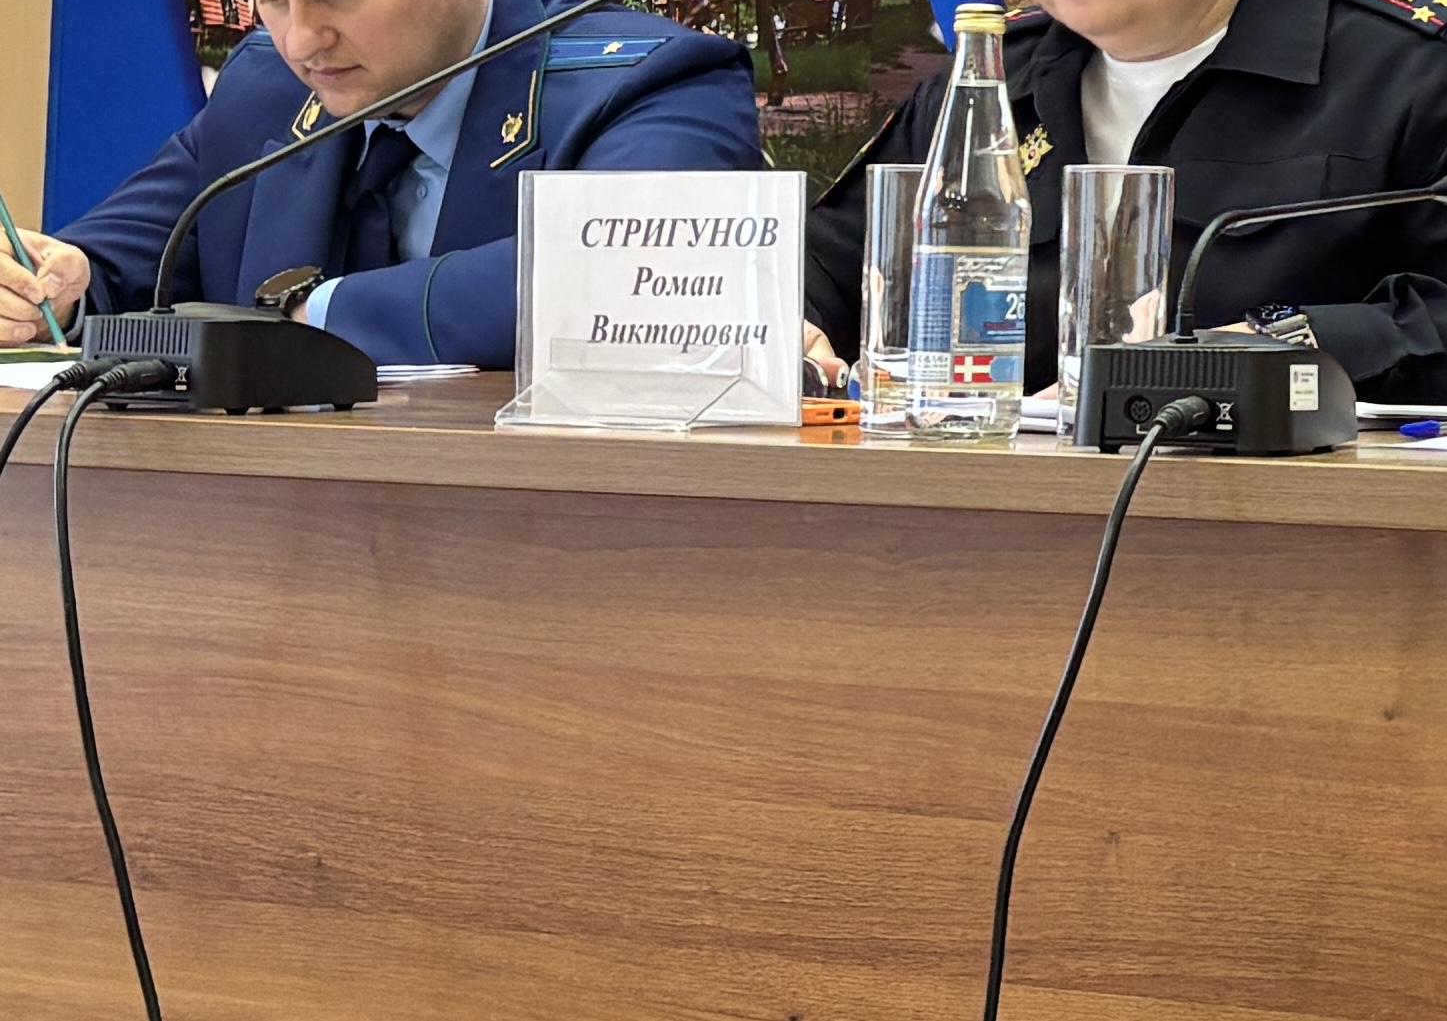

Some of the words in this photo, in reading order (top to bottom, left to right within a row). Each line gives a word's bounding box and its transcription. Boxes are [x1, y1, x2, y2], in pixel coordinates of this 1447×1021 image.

[580, 216, 779, 249] СТРИГУНОВ
[631, 265, 724, 298] Роман
[586, 313, 769, 354] Викторович
